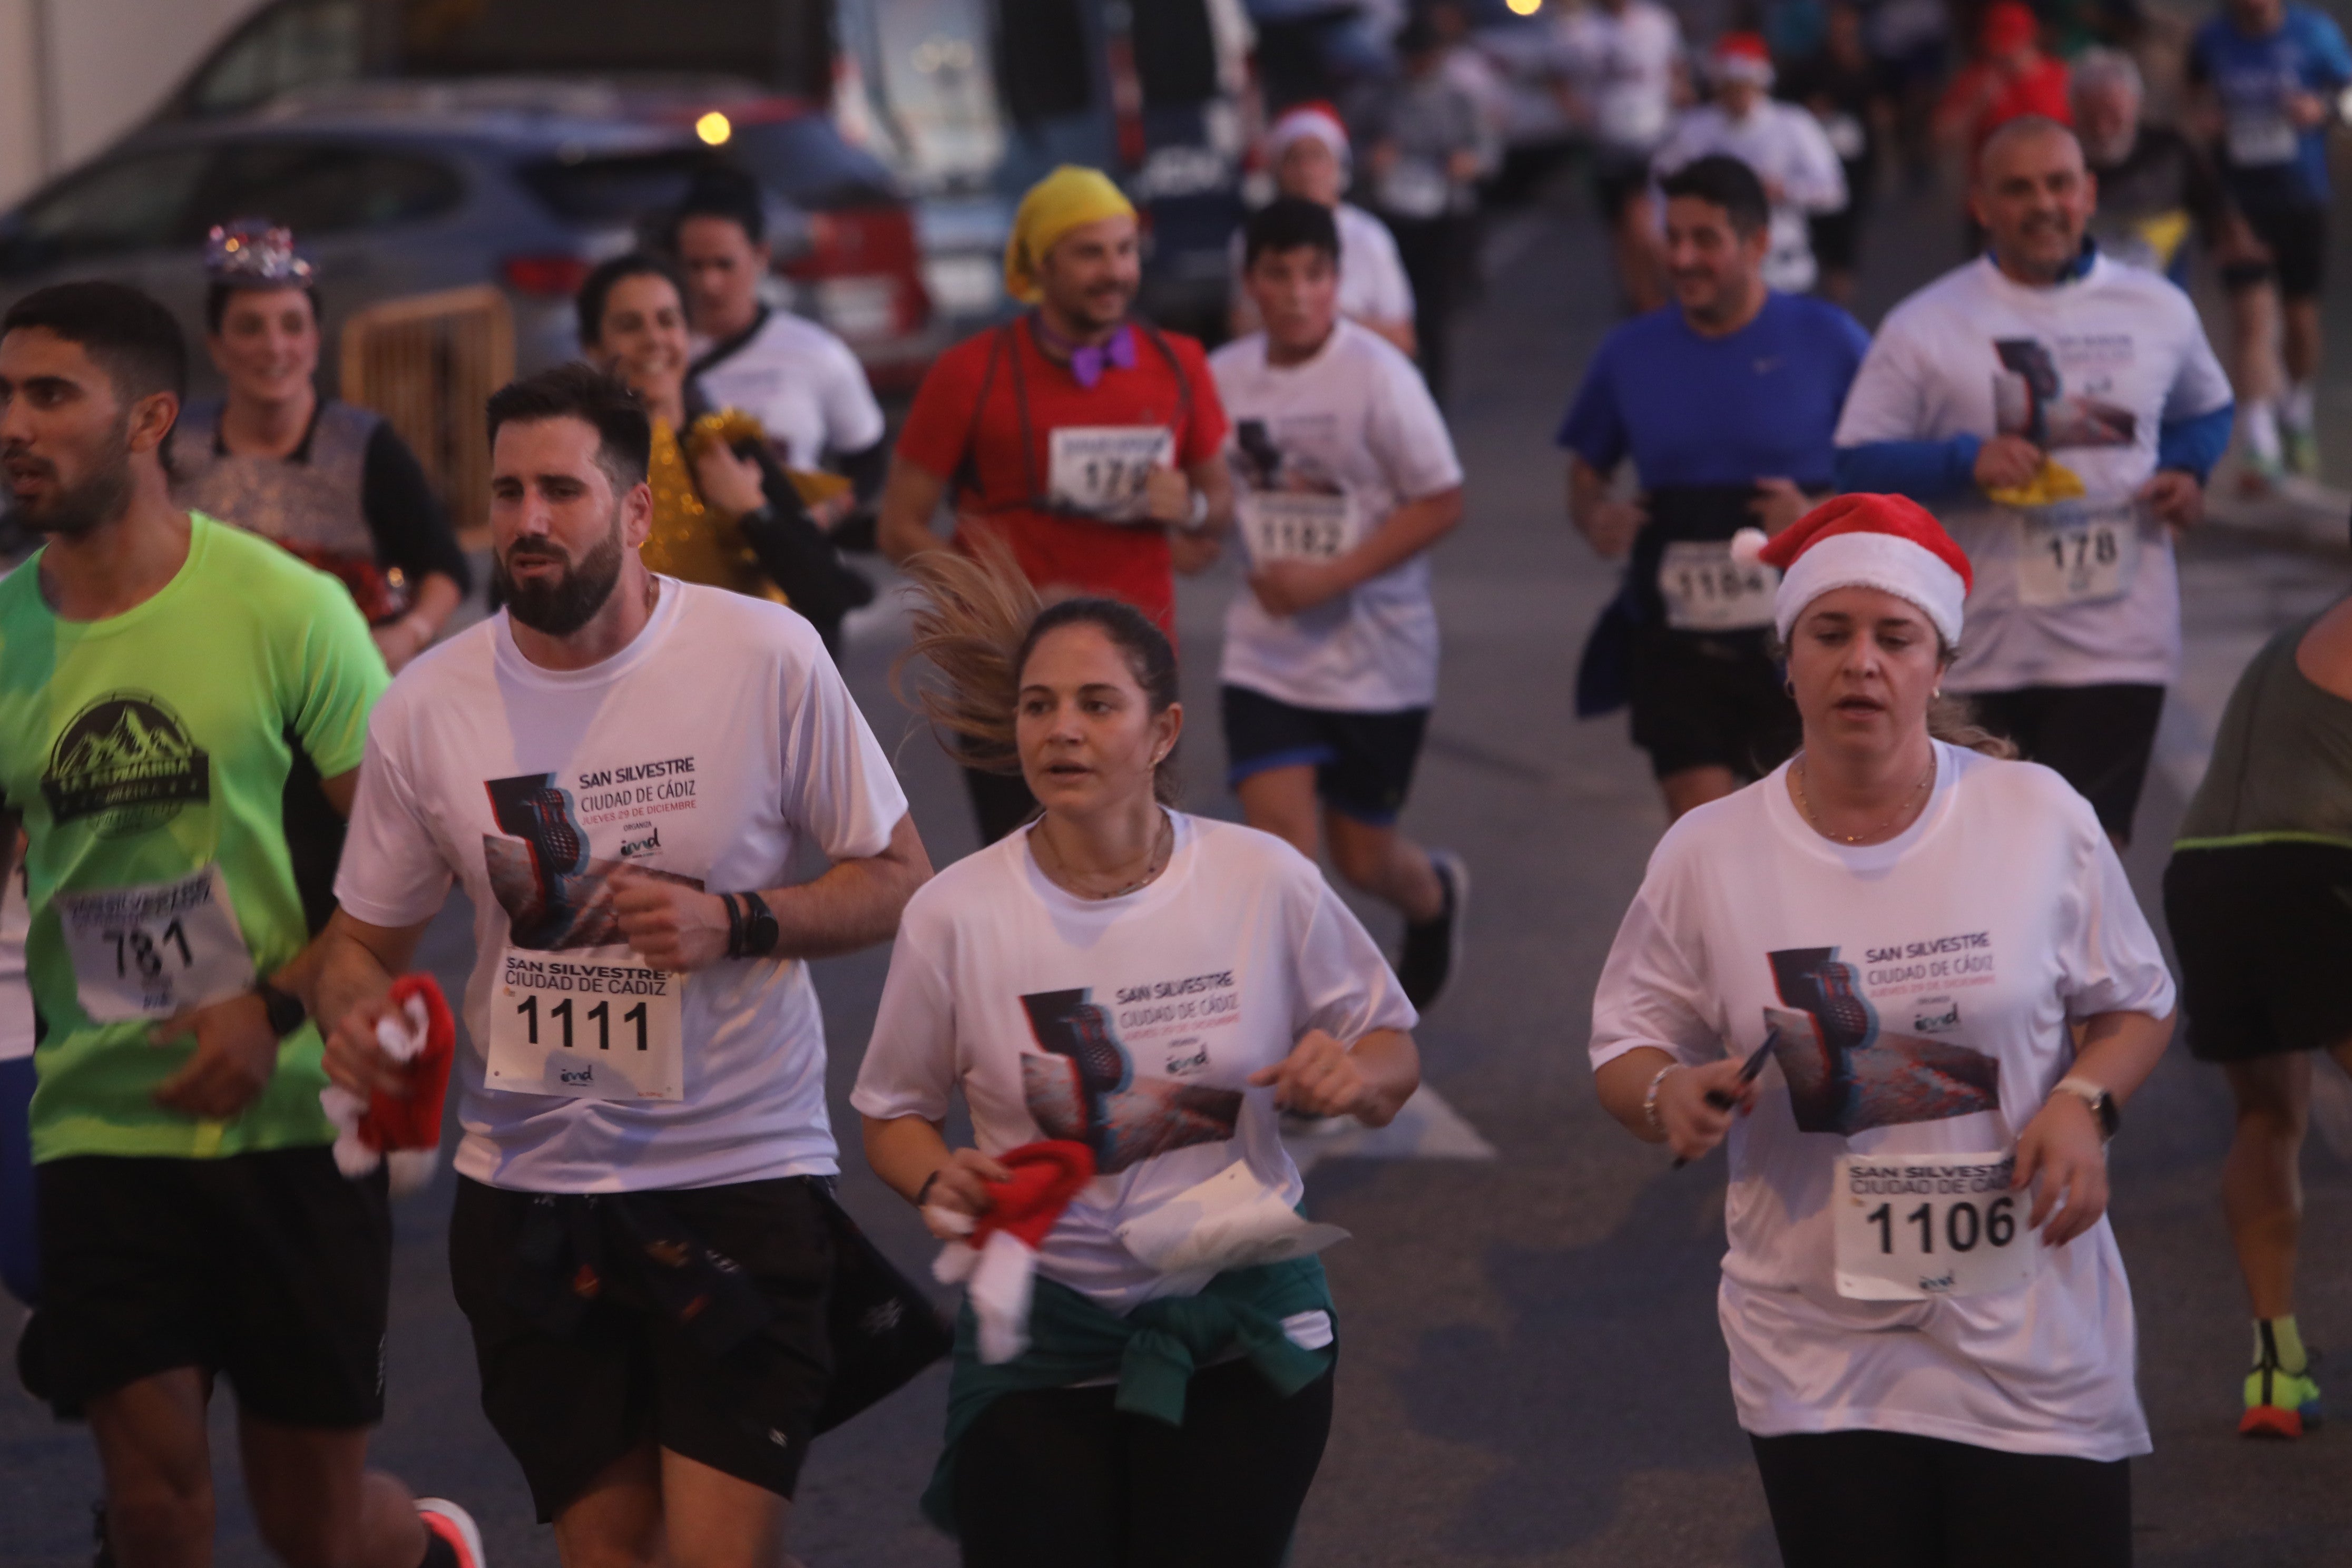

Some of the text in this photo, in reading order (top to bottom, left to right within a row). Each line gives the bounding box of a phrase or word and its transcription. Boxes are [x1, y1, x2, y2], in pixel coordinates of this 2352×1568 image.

[2049, 527, 2117, 570] 178
[580, 757, 695, 789] SAN SILVESTRE
[581, 779, 696, 812] CIUDAD DE CÁDIZ
[582, 799, 697, 826] JUEVES 29 DE DICIEMBRE
[623, 821, 652, 831] ORGANIZA
[102, 917, 193, 978] 781
[1865, 931, 1990, 964] SAN SILVESTRE
[505, 970, 573, 991] CIUDAD
[579, 977, 603, 993] DE
[506, 957, 667, 980] SAN SILVESTRE
[1868, 965, 1925, 985] CIUDAD
[1930, 961, 1948, 976] DE
[1115, 969, 1234, 1005] SAN SILVESTRE
[517, 995, 648, 1051] 1111
[1120, 1005, 1174, 1028] CIUDAD
[1178, 1000, 1197, 1020] DE
[1850, 1166, 1898, 1178] SAN
[1850, 1179, 1930, 1194] CIUDAD
[1938, 1179, 1965, 1194] DE
[1867, 1197, 2015, 1254] 1106
